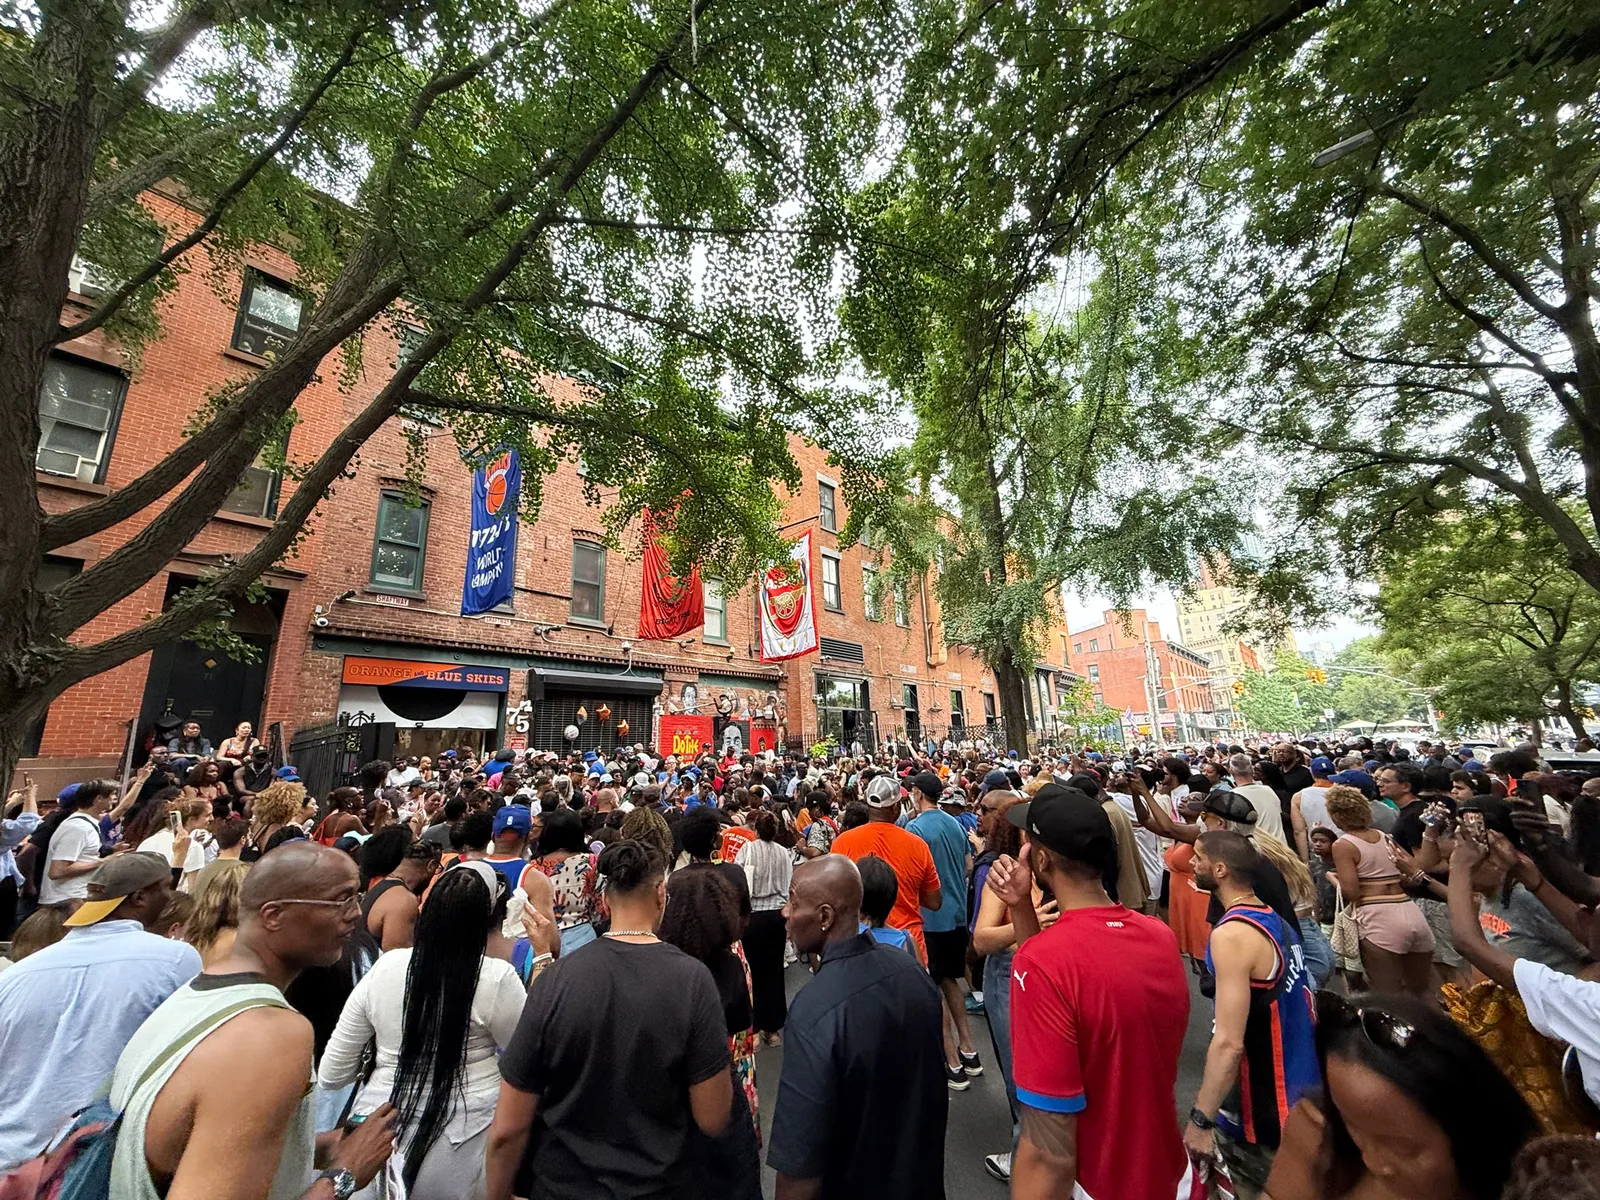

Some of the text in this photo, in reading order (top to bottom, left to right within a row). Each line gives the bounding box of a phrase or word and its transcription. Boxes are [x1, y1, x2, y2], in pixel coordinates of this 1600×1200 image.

[350, 665, 411, 678] ORANGE
[426, 670, 462, 682] BLUE
[466, 673, 504, 685] SKIES
